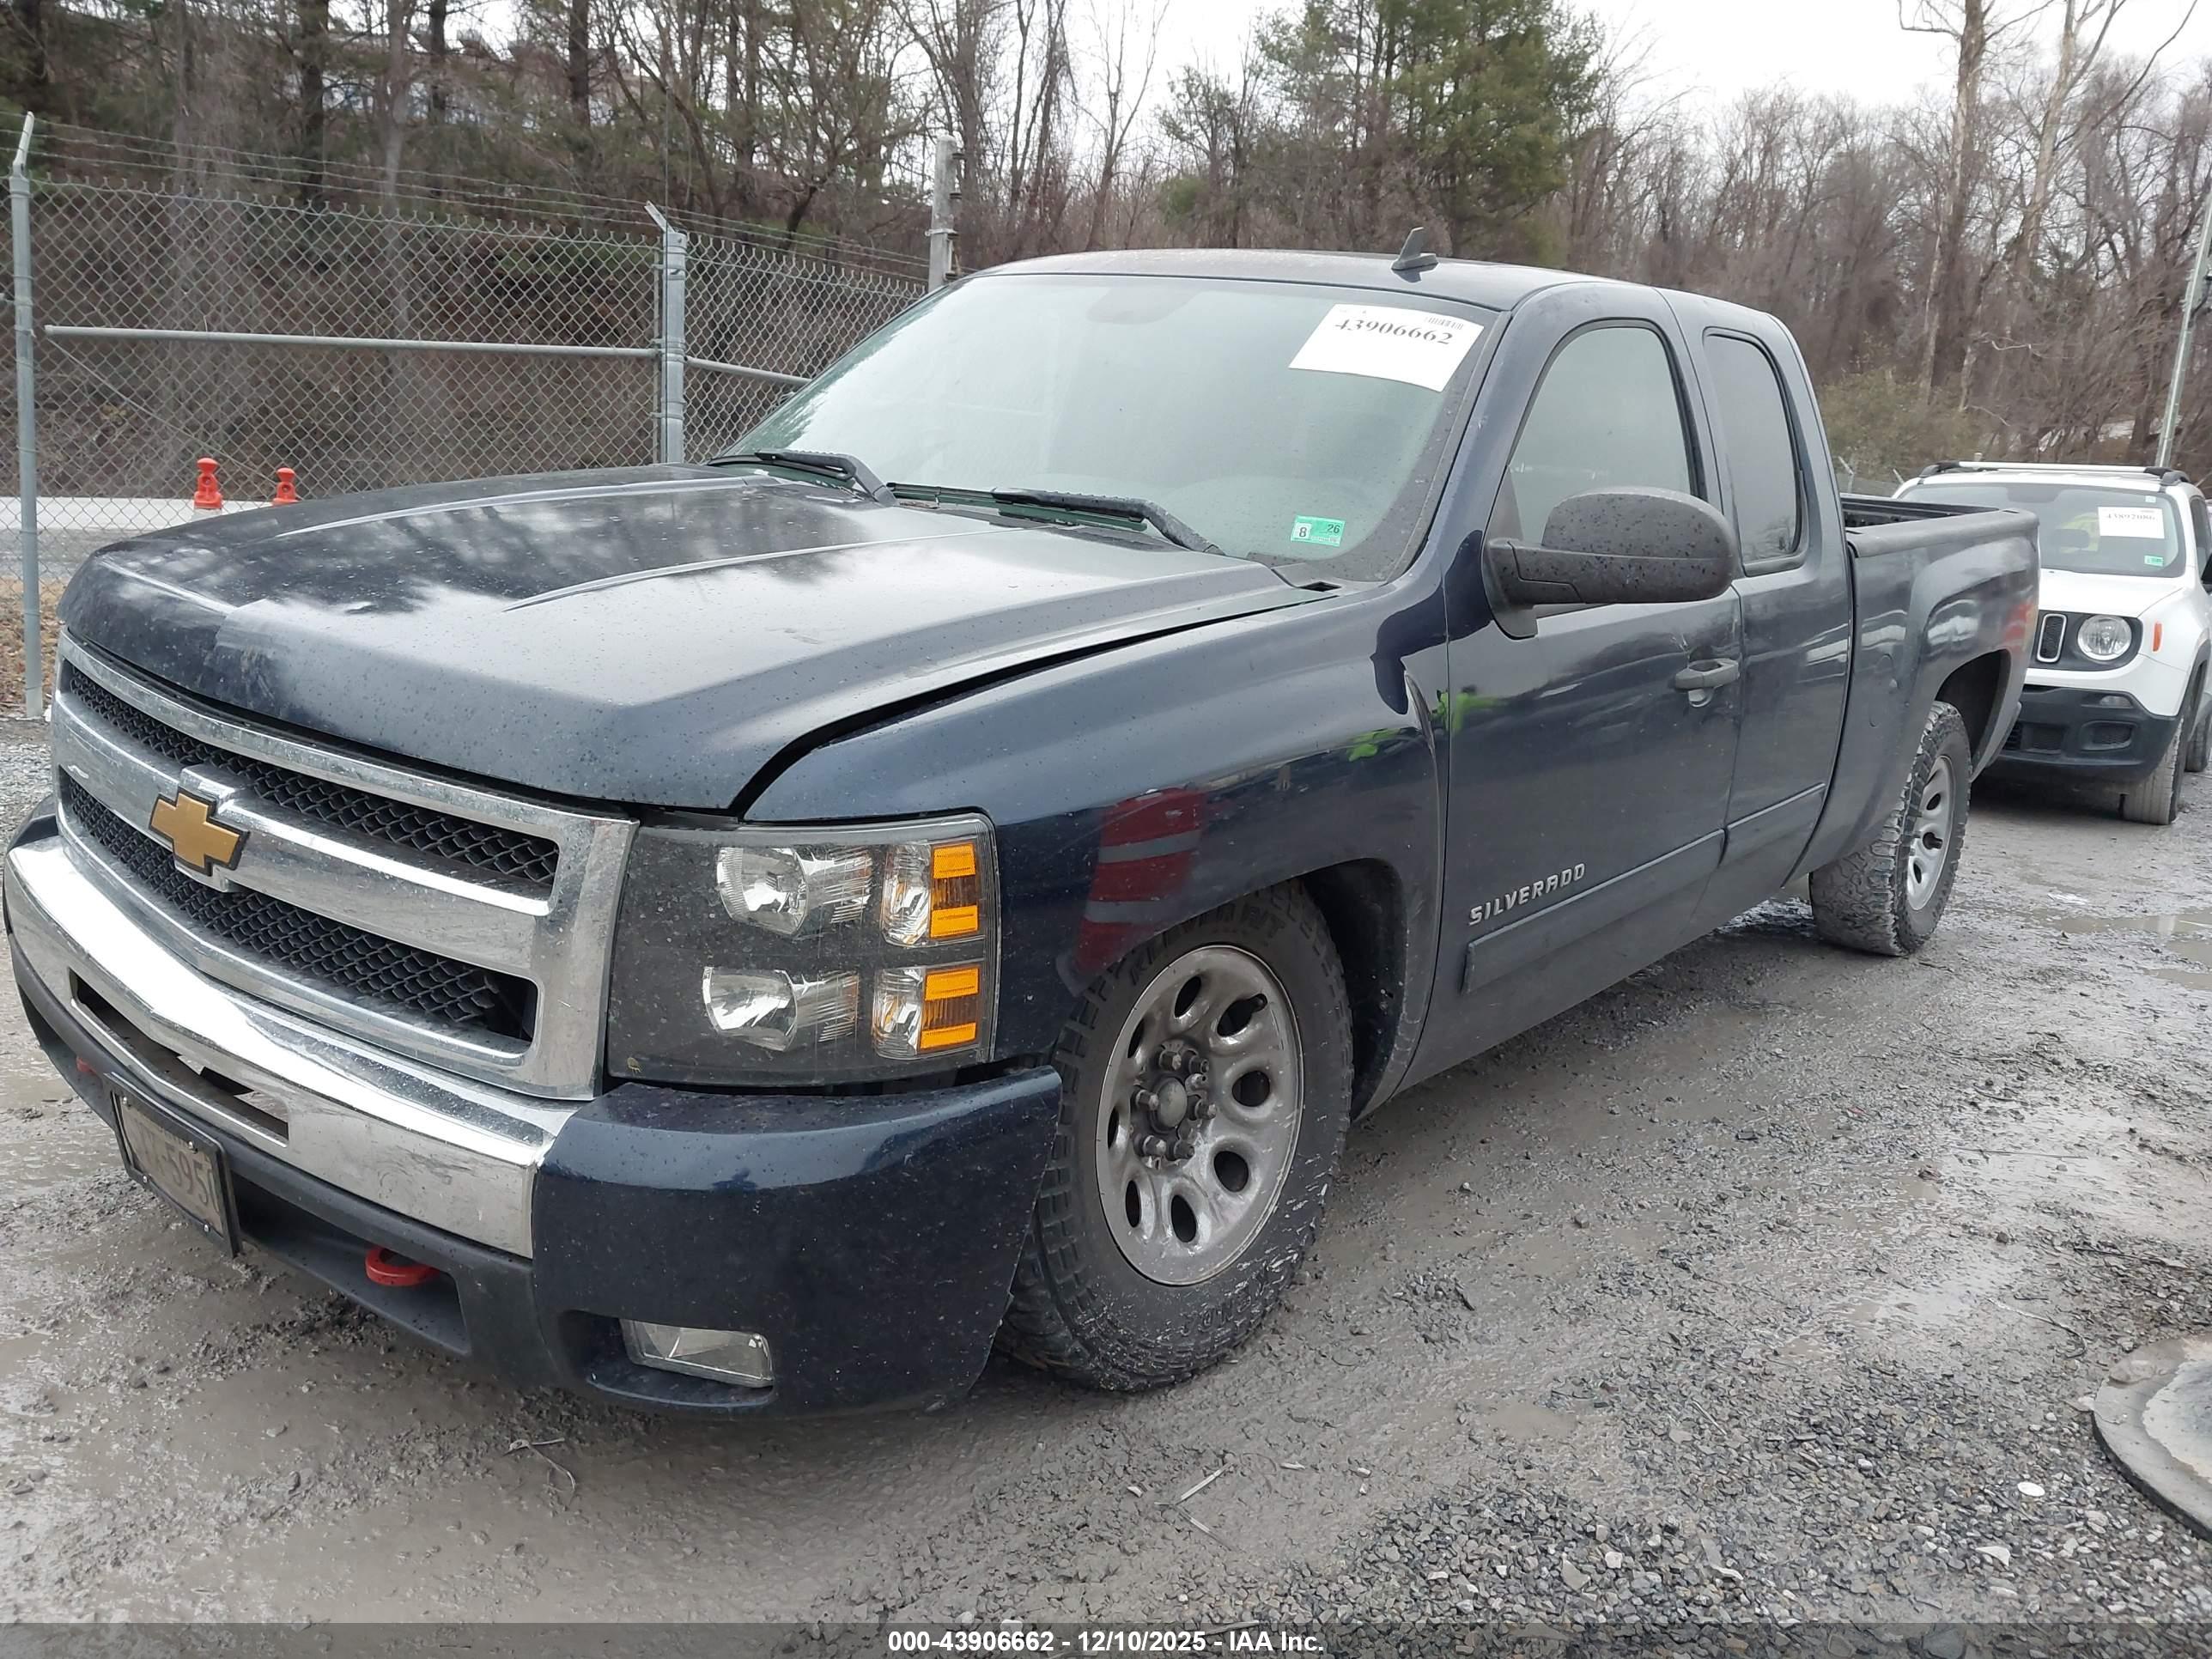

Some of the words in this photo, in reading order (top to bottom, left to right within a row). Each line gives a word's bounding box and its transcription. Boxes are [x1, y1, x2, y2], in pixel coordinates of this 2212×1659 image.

[1334, 319, 1453, 344] 43906662
[1298, 526, 1308, 538] 8
[1327, 524, 1340, 534] 26
[1468, 863, 1586, 926] SILVERADO
